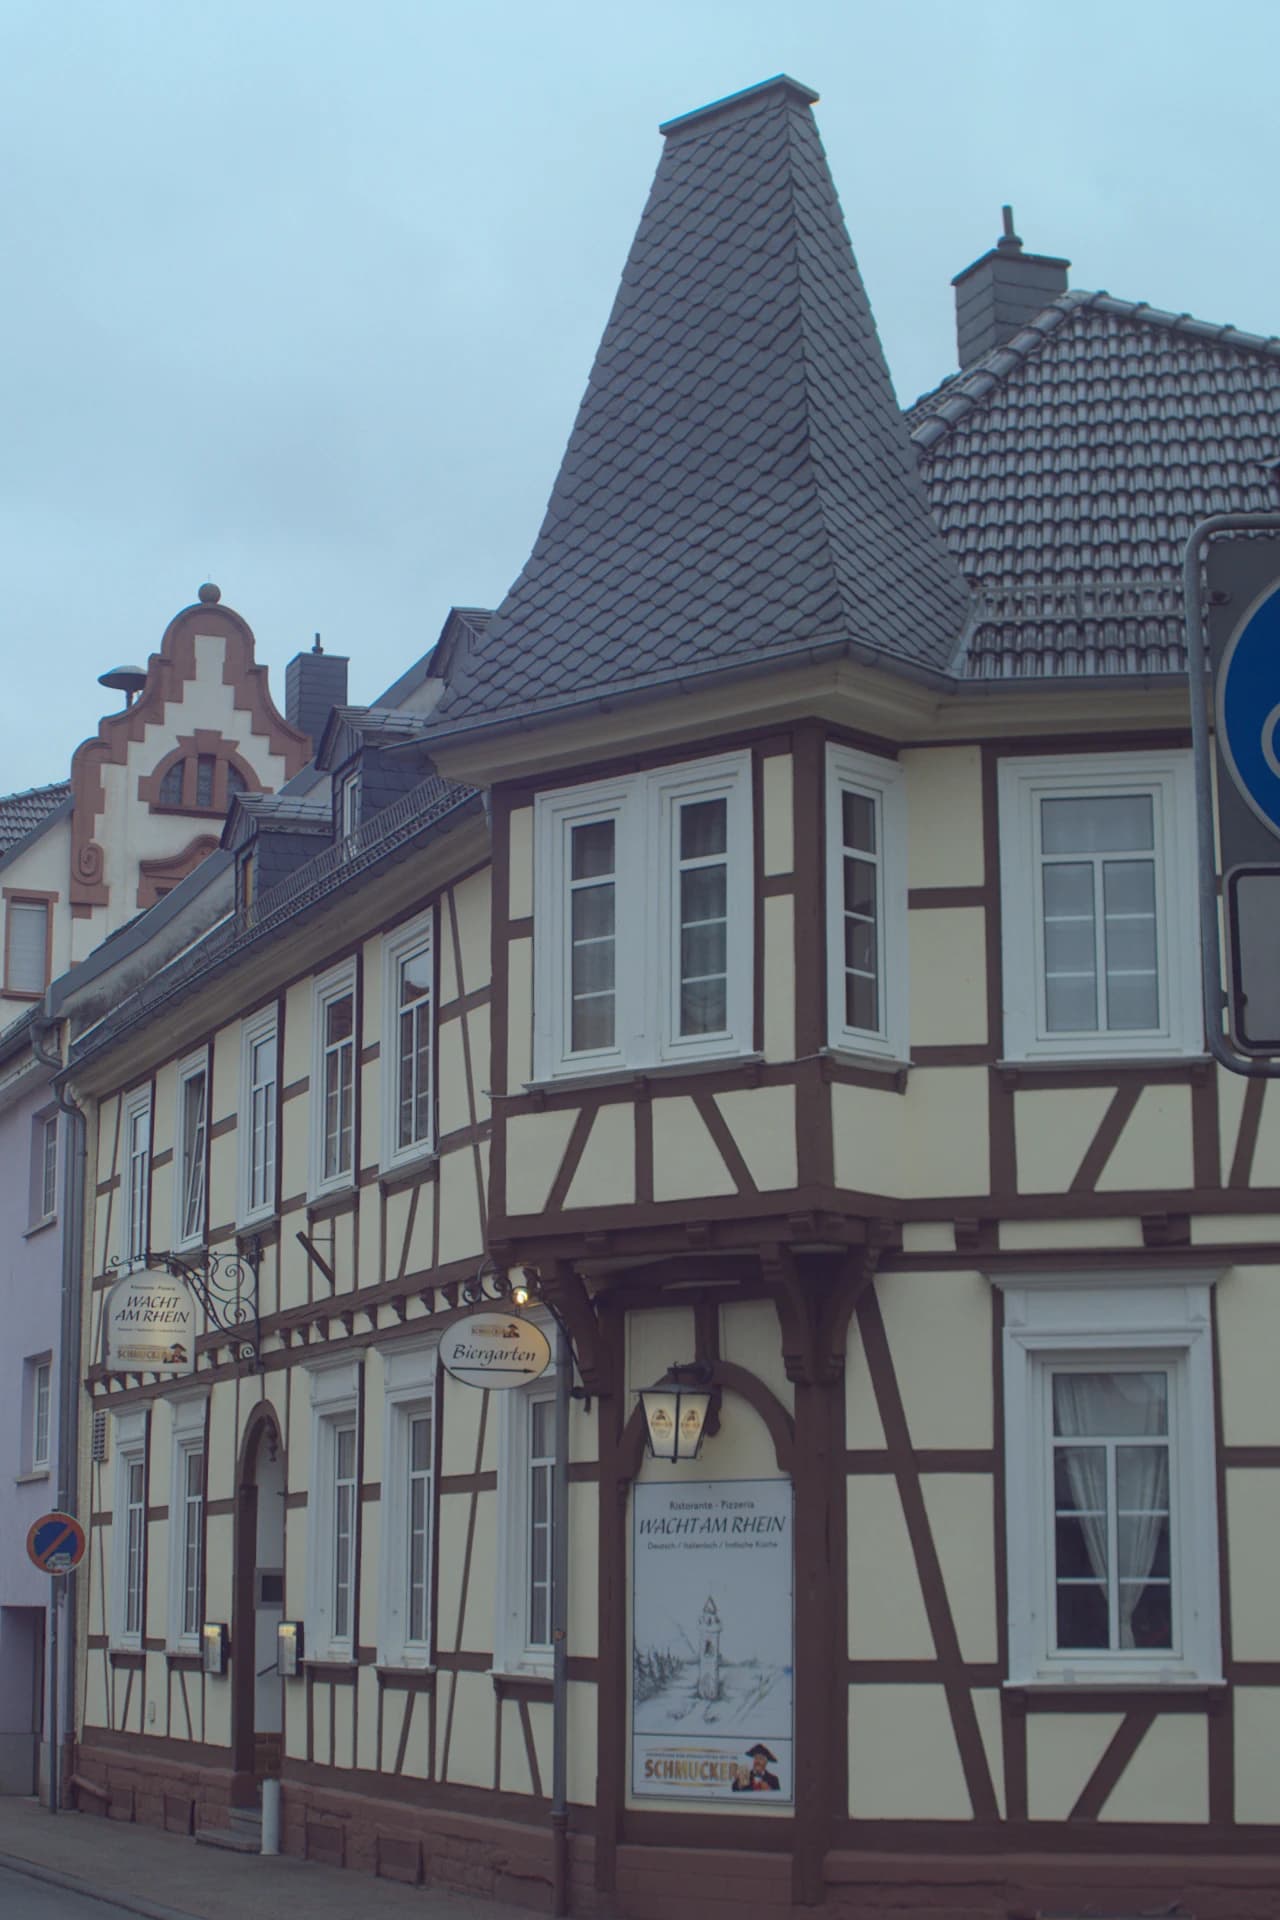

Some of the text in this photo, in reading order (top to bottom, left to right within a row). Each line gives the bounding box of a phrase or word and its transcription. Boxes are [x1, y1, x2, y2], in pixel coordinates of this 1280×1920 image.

[127, 1296, 181, 1309] WACHT
[115, 1309, 190, 1323] AM RHEIN
[453, 1344, 536, 1366] Biergarten
[669, 1501, 713, 1511] Ristorante
[720, 1500, 755, 1510] Pizzeria
[639, 1516, 786, 1534] WACHT AM RHEIN
[644, 1759, 738, 1781] SCHMUCKER
